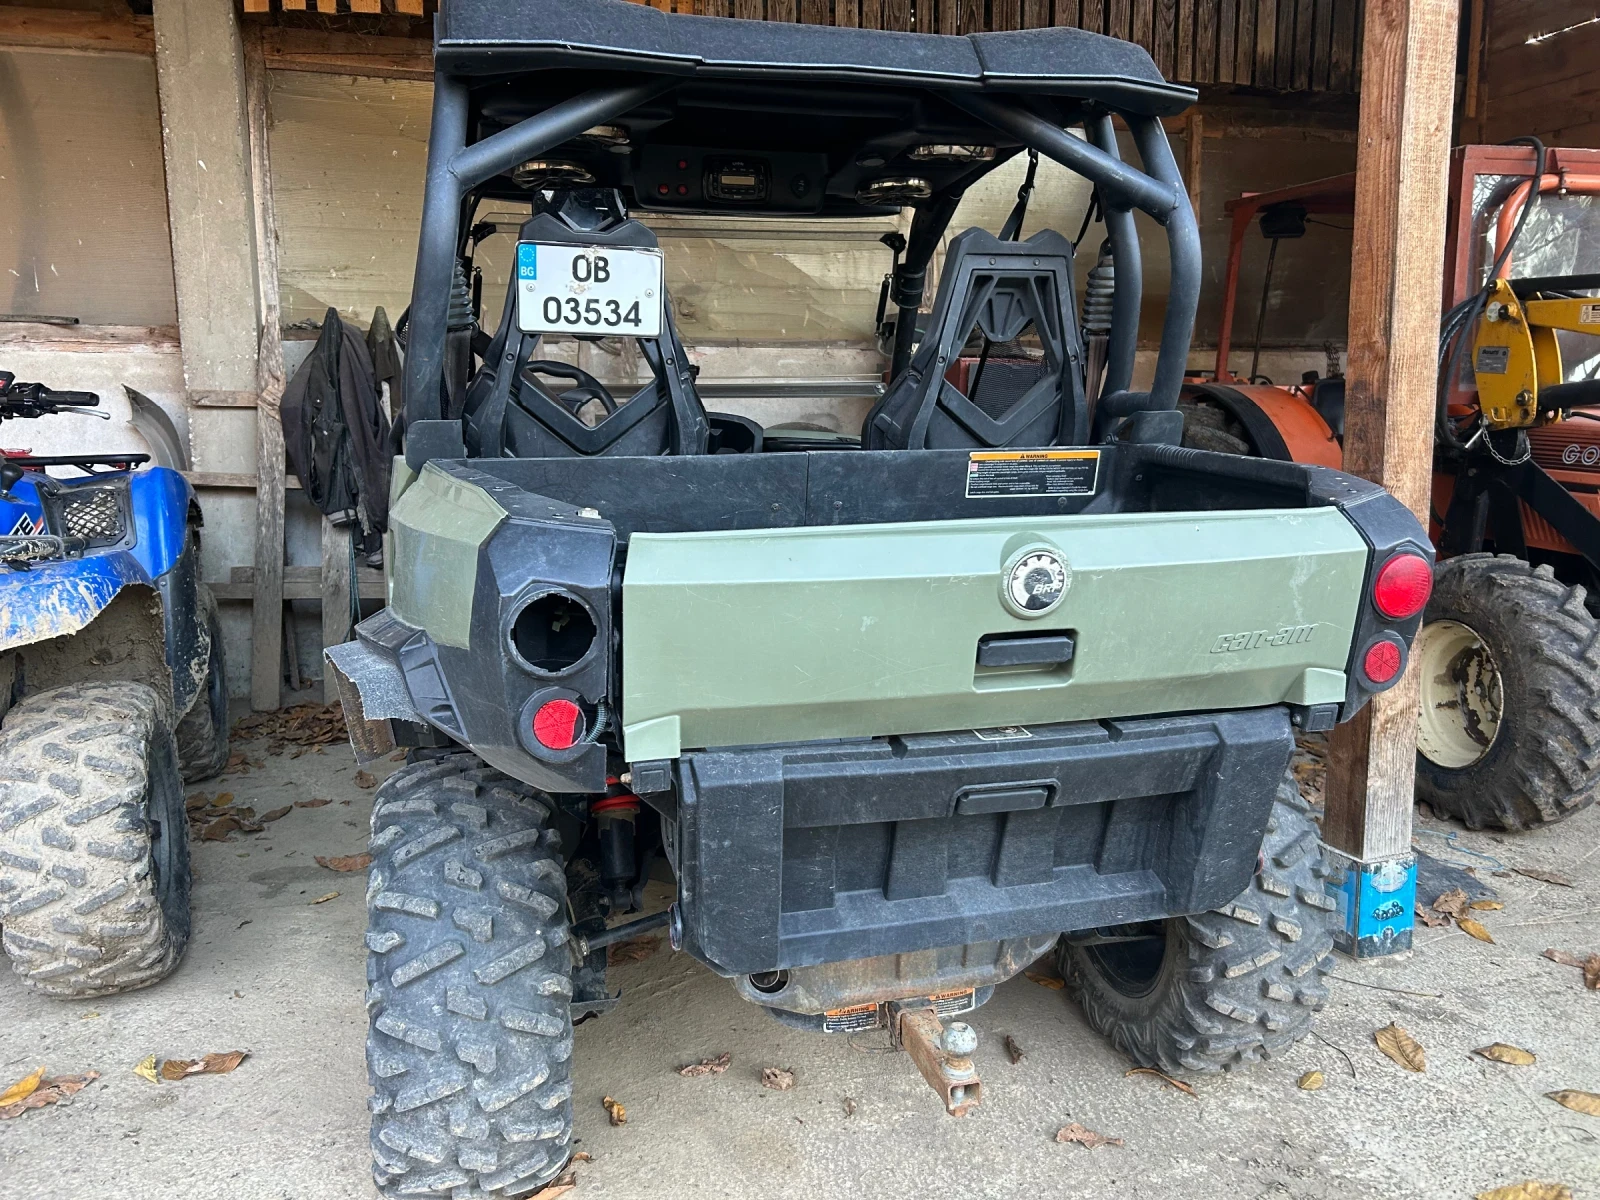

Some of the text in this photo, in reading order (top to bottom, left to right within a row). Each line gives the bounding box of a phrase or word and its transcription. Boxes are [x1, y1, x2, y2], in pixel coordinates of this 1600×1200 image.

[520, 266, 535, 277] BG
[572, 254, 610, 283] OB
[543, 296, 642, 327] 03534
[1562, 443, 1600, 466] GO
[1032, 583, 1062, 595] BRP
[940, 989, 968, 1000] WARNING
